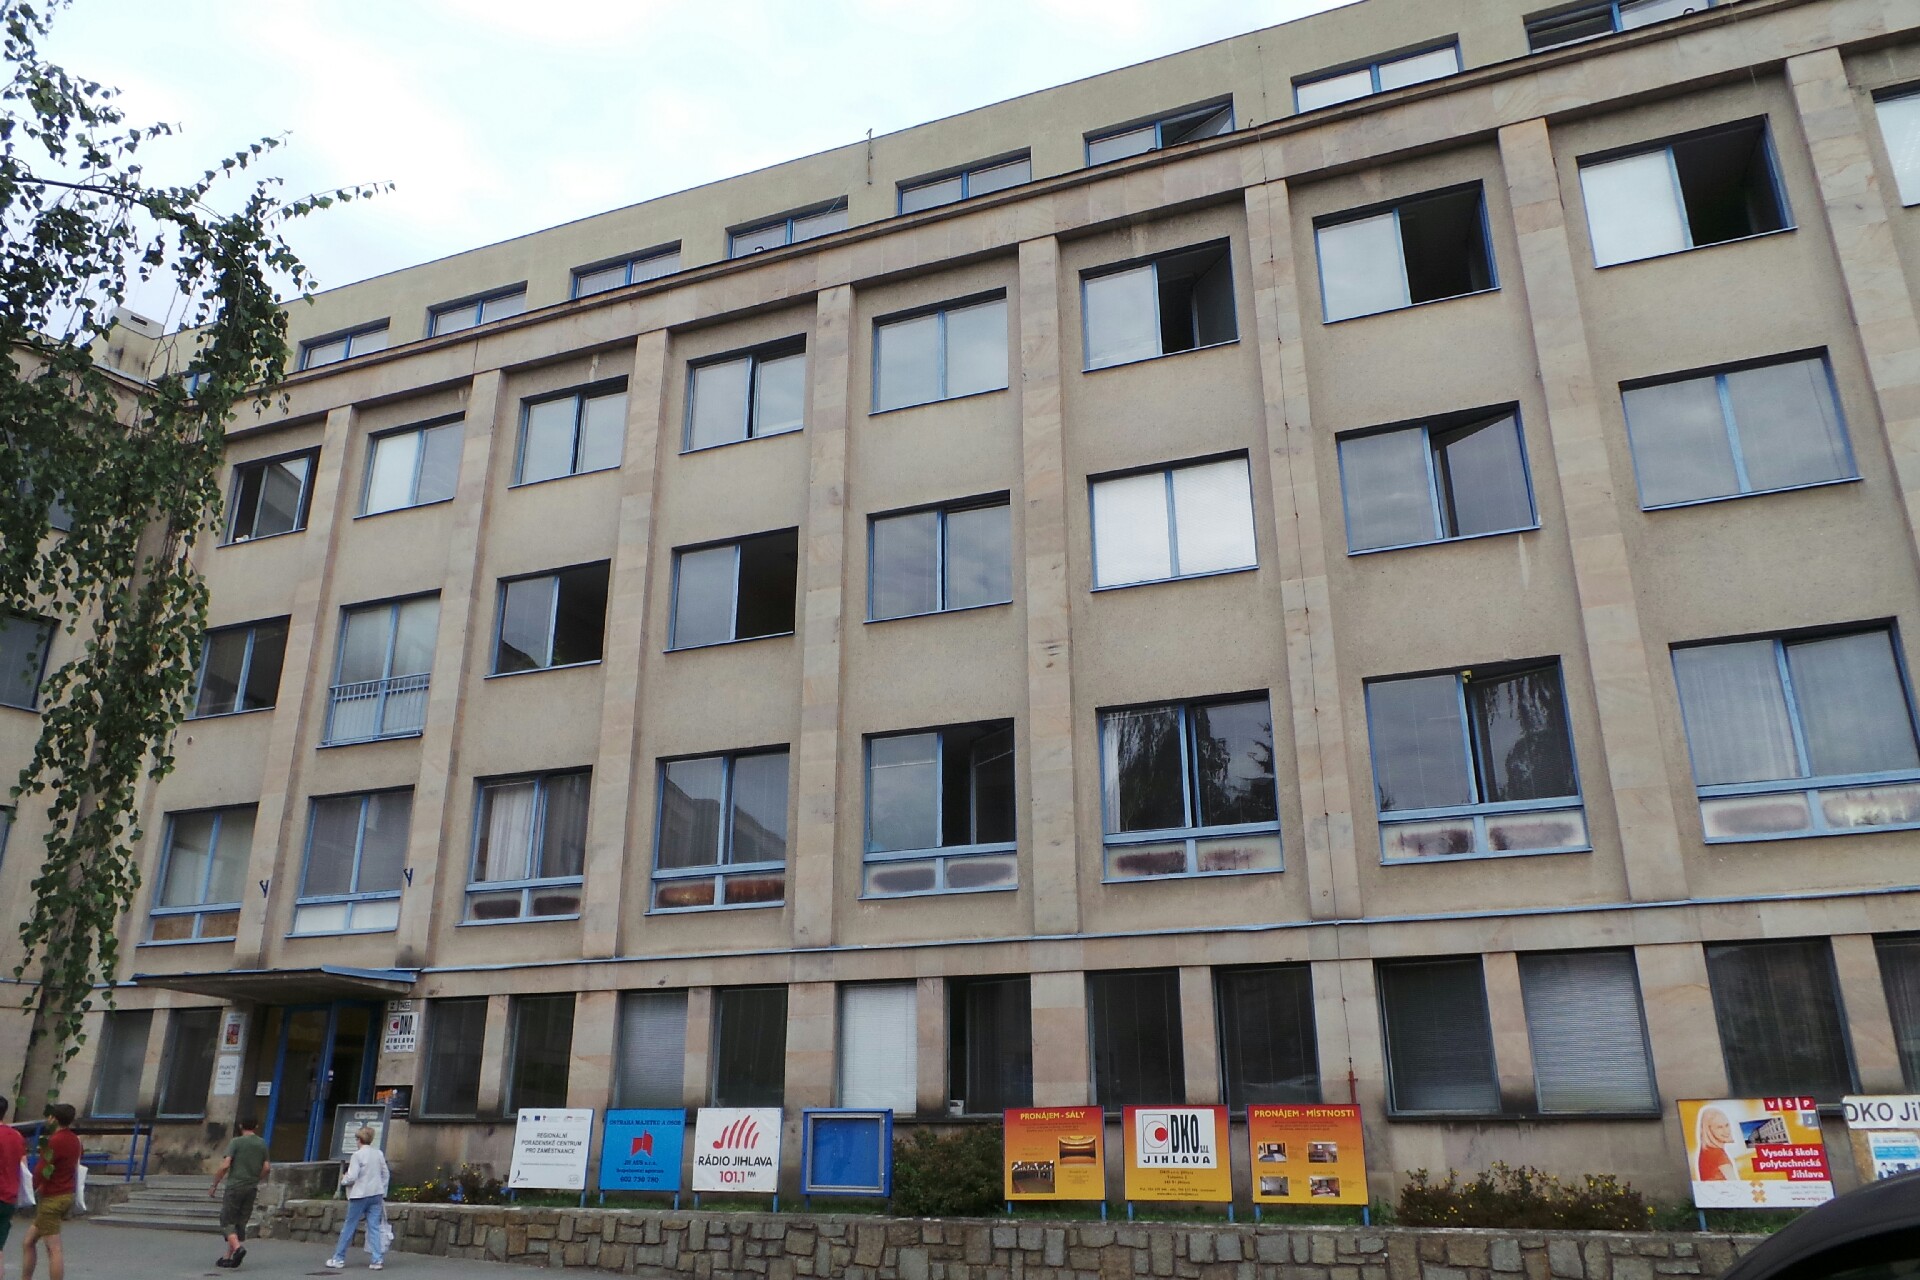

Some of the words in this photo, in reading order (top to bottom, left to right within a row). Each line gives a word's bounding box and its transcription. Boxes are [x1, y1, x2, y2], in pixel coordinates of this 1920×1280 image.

[399, 1014, 413, 1035] DKO
[1020, 1111, 1060, 1120] PRONÁJEM
[1065, 1110, 1085, 1119] SÁLY
[1254, 1109, 1299, 1118] PRONÁJEM
[1306, 1108, 1355, 1118] MÍSTNOSTI
[1899, 1101, 1920, 1121] Ji
[1170, 1114, 1200, 1154] DKO
[1143, 1155, 1211, 1164] JIHLAVA
[1761, 1148, 1793, 1159] Vysoká
[1795, 1147, 1819, 1157] škola
[698, 1153, 730, 1166] RÁDIO
[732, 1156, 773, 1167] JIHLAVA
[1759, 1158, 1822, 1171] polytechnická
[719, 1170, 745, 1183] 101.1
[1791, 1169, 1824, 1179] Jihlava
